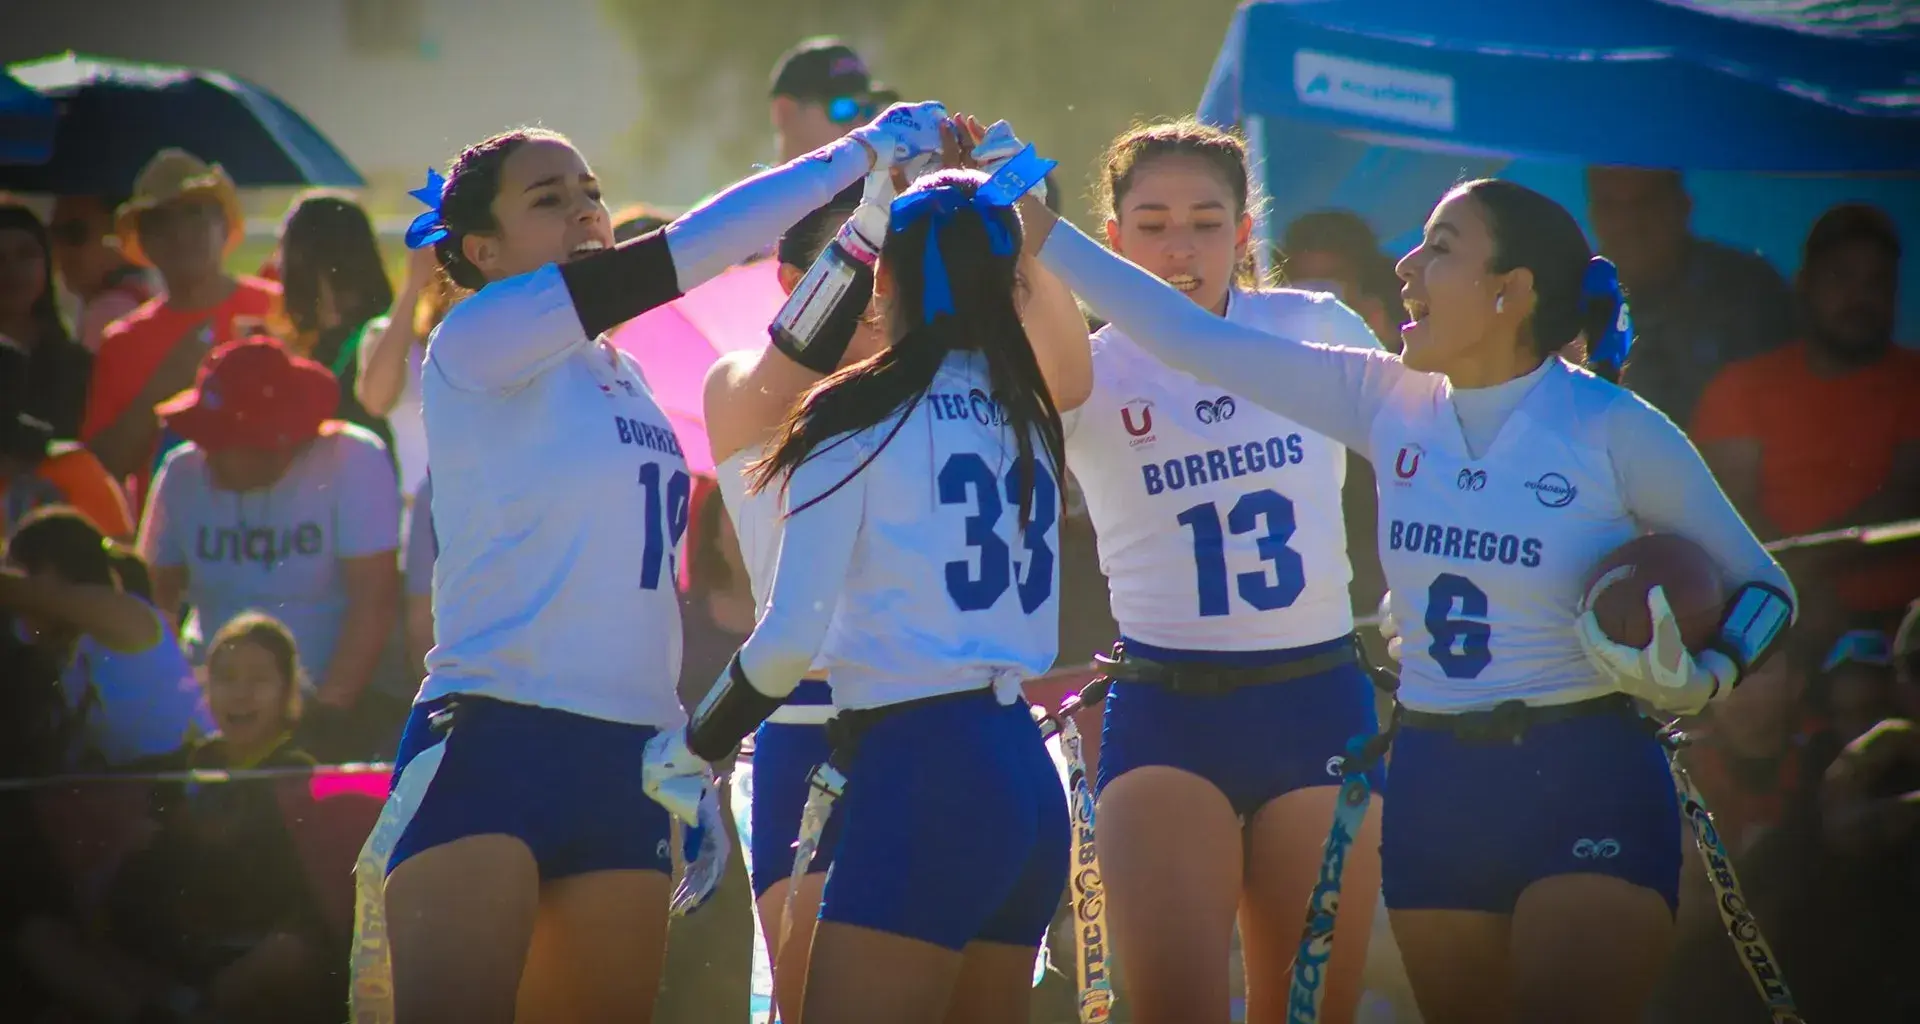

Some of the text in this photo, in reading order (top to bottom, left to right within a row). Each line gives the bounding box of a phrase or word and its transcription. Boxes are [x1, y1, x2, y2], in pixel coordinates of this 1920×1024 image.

[615, 416, 685, 459] BORRE
[927, 394, 968, 420] TEC
[1142, 433, 1304, 495] BORREGOS
[938, 453, 1056, 615] 33
[1176, 488, 1306, 617] 13
[1390, 520, 1544, 568] BORREGOS
[1424, 572, 1493, 679] 6
[1084, 923, 1105, 989] TEC
[1745, 944, 1786, 999] TEC
